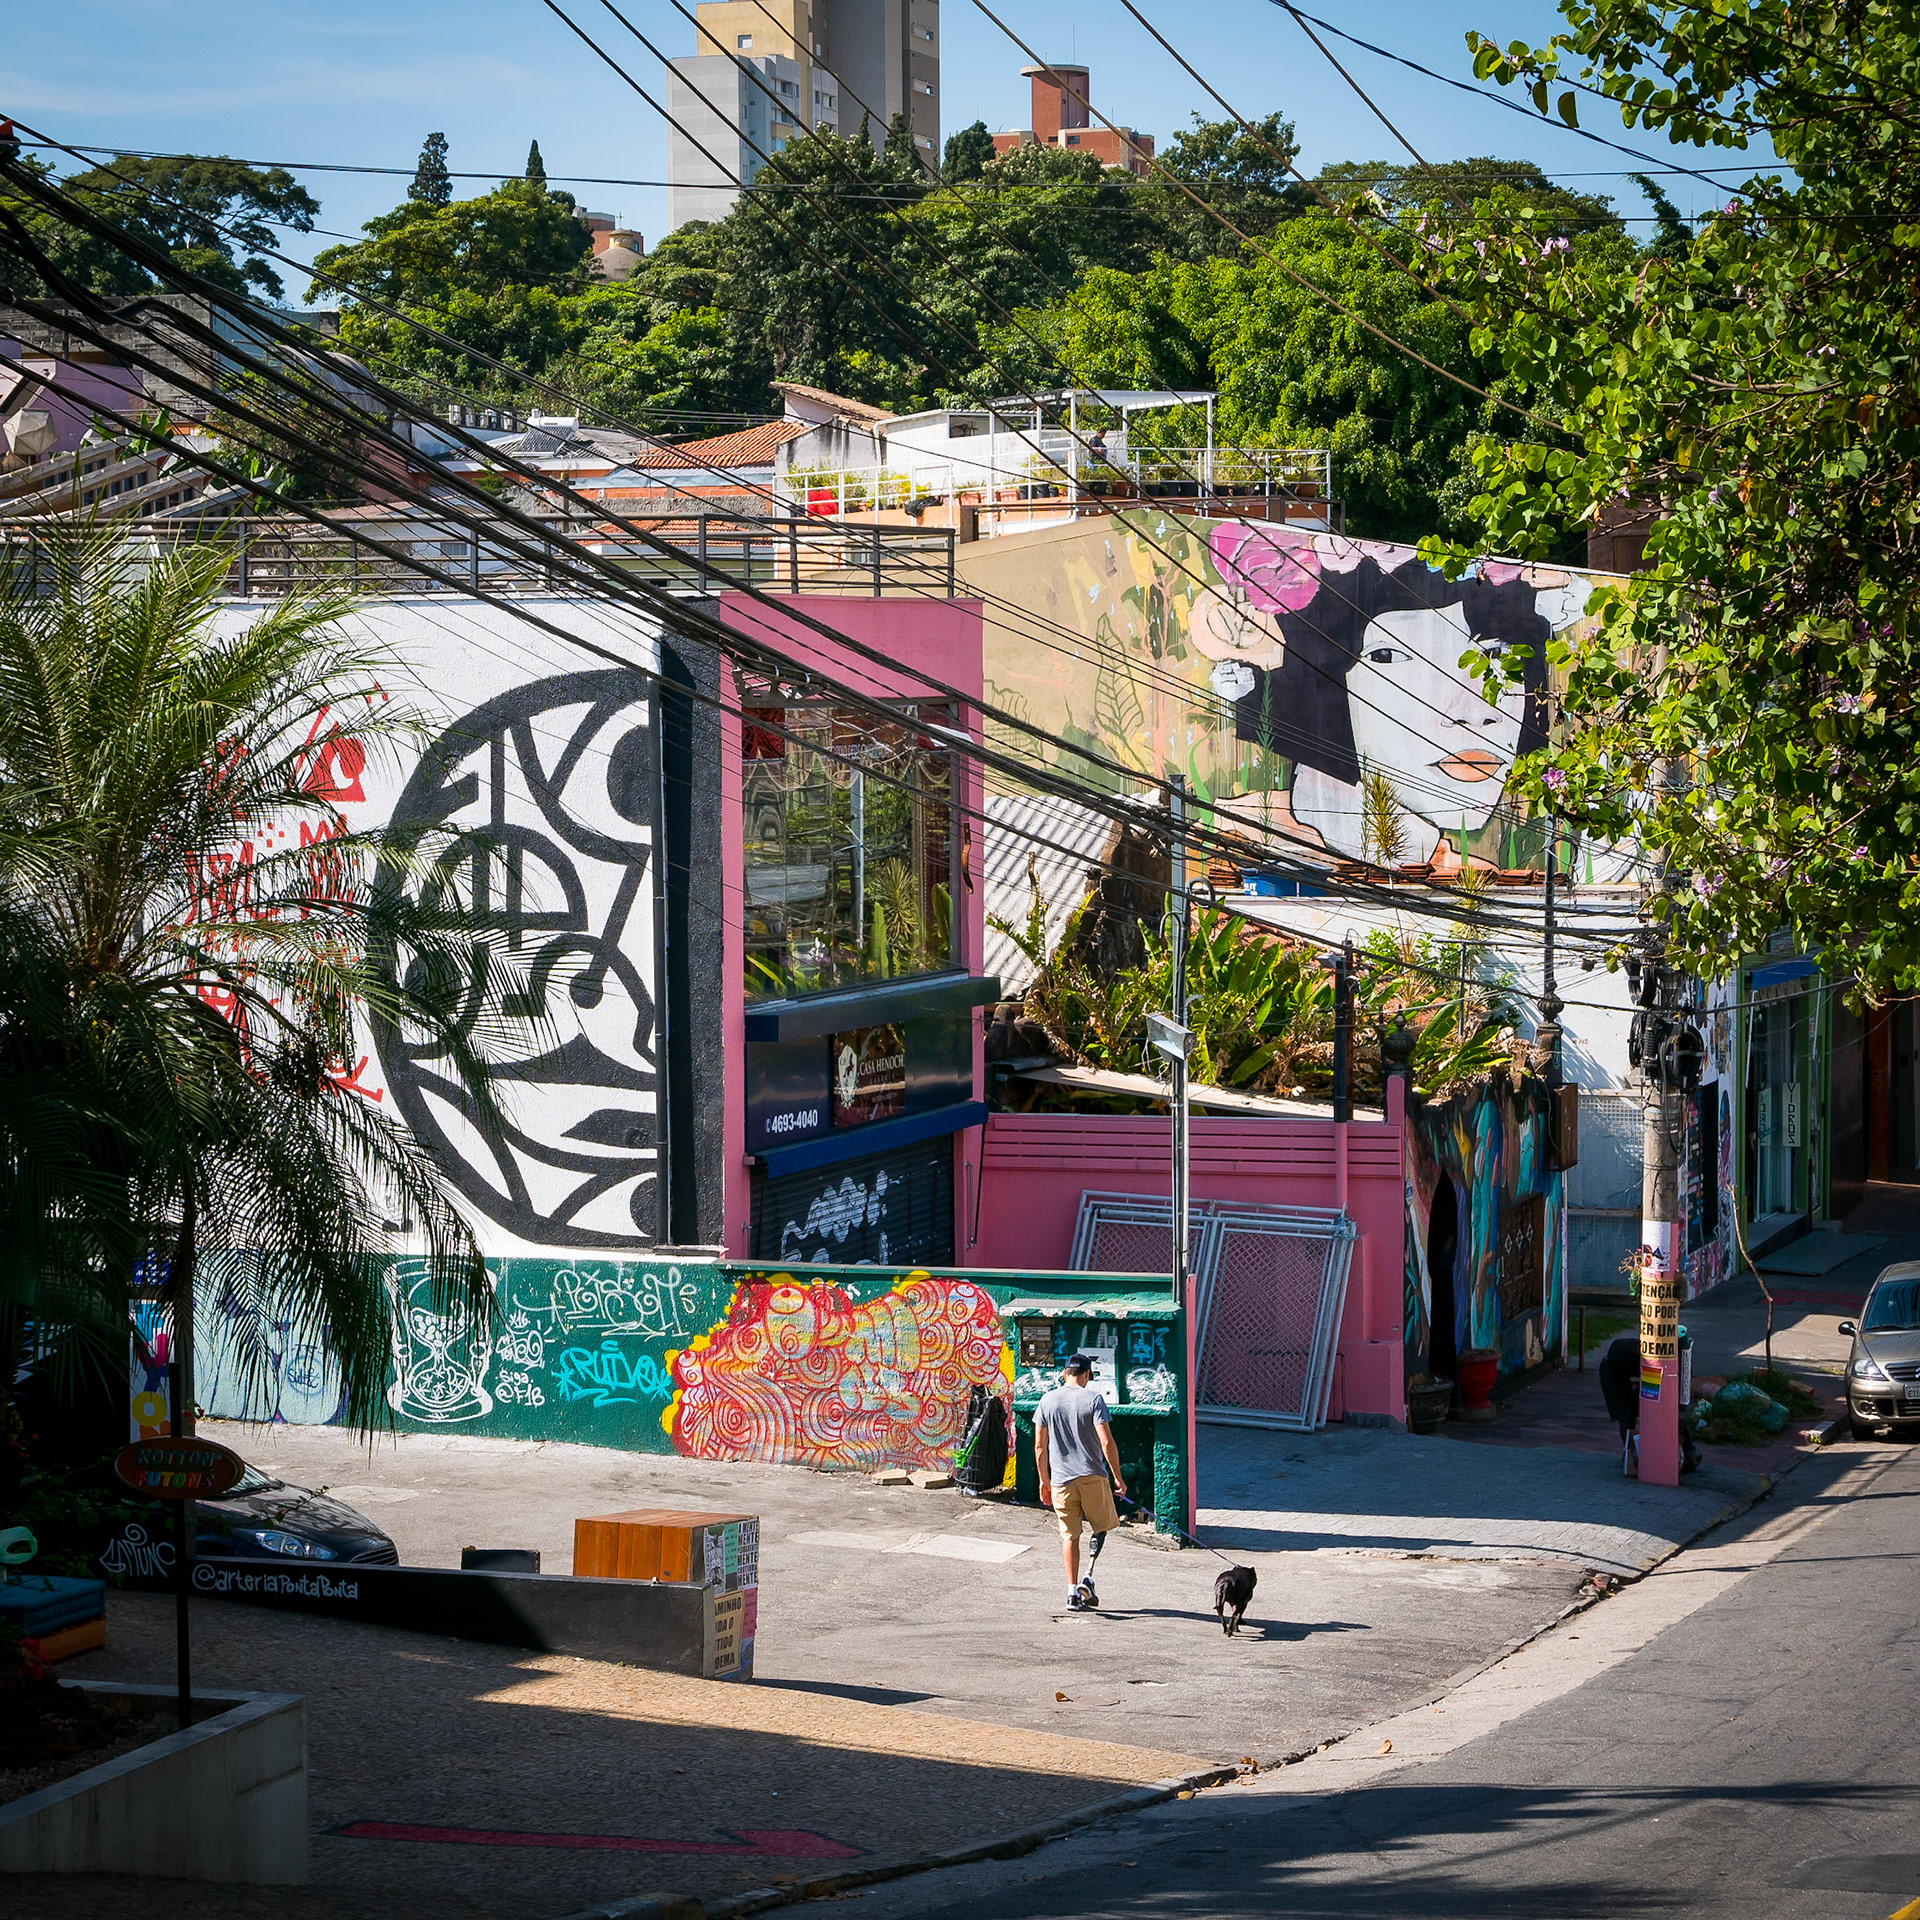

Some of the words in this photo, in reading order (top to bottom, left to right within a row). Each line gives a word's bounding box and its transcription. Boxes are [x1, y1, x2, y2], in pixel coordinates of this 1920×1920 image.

[860, 1061, 875, 1076] CASA
[876, 1054, 904, 1071] HENOCH
[772, 1109, 818, 1133] 4693-4040
[1787, 1083, 1796, 1144] VIDROS
[1641, 1282, 1678, 1301] TENÇÃO
[1655, 1305, 1677, 1319] PODE
[1641, 1322, 1654, 1336] ER
[1657, 1323, 1676, 1337] UM
[1641, 1341, 1675, 1356] OEMA
[1908, 1389, 1920, 1398] EU
[135, 1468, 213, 1488] FUTONS
[714, 1635, 733, 1651] TIDO
